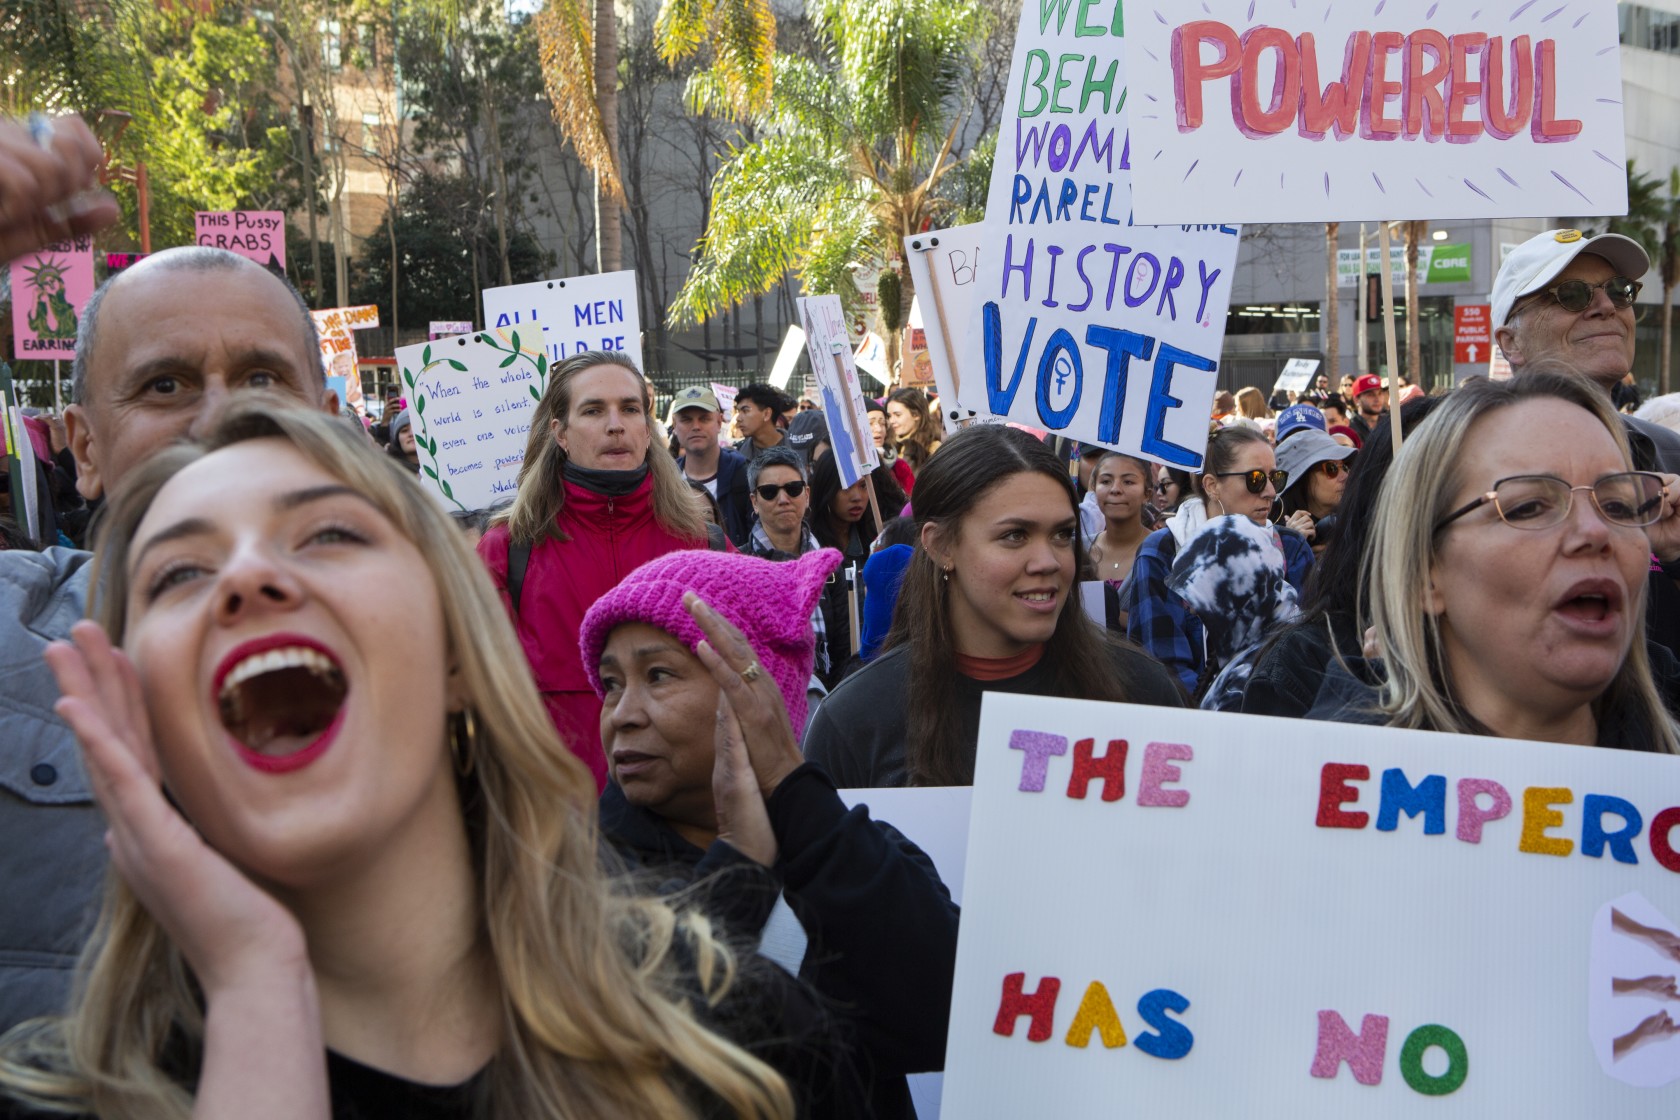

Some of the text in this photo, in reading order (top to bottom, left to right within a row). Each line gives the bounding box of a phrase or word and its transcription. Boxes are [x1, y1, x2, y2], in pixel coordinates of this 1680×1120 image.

[1017, 49, 1128, 118] BEH
[1009, 173, 1134, 226] RAREL
[199, 214, 230, 227] THIS
[199, 233, 272, 251] GRABS
[1434, 258, 1467, 269] CBRE
[1001, 234, 1222, 324] HISTORY
[574, 299, 624, 328] MEN
[1456, 335, 1489, 343] PARKING
[1459, 326, 1487, 334] PUBLIC
[472, 377, 490, 390] the
[501, 368, 532, 384] whole
[982, 301, 1218, 468] VOTE
[434, 412, 462, 426] world
[473, 409, 483, 419] is
[443, 424, 531, 450] even one voice
[447, 461, 483, 476] becomes
[1009, 729, 1194, 808] THE
[993, 972, 1469, 1097] HAS NO
